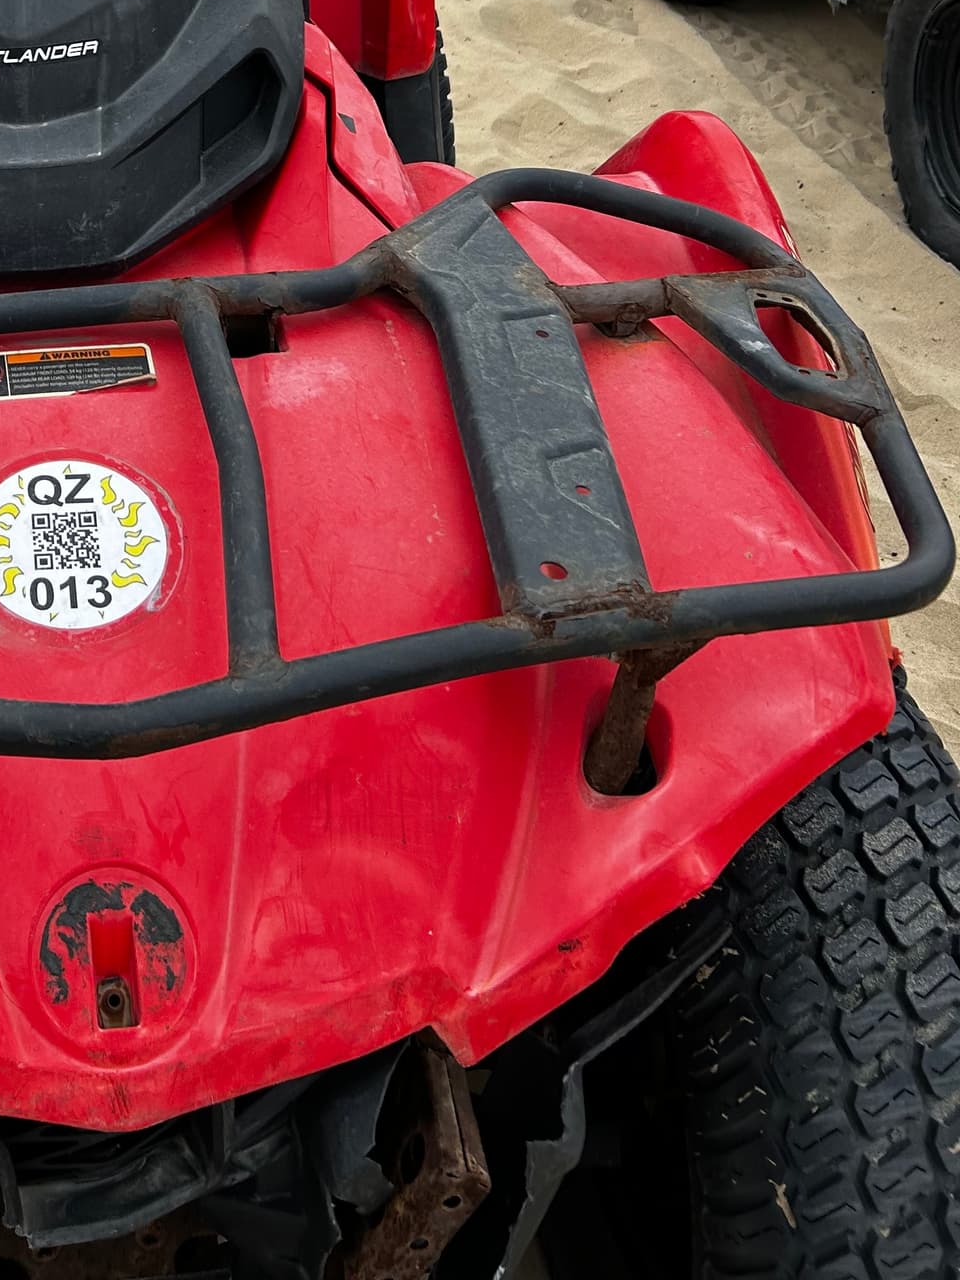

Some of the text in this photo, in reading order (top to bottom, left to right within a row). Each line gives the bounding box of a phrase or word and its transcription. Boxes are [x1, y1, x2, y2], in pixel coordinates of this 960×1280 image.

[52, 350, 111, 360] WARNING
[28, 473, 93, 507] QZ
[29, 575, 112, 610] 013
